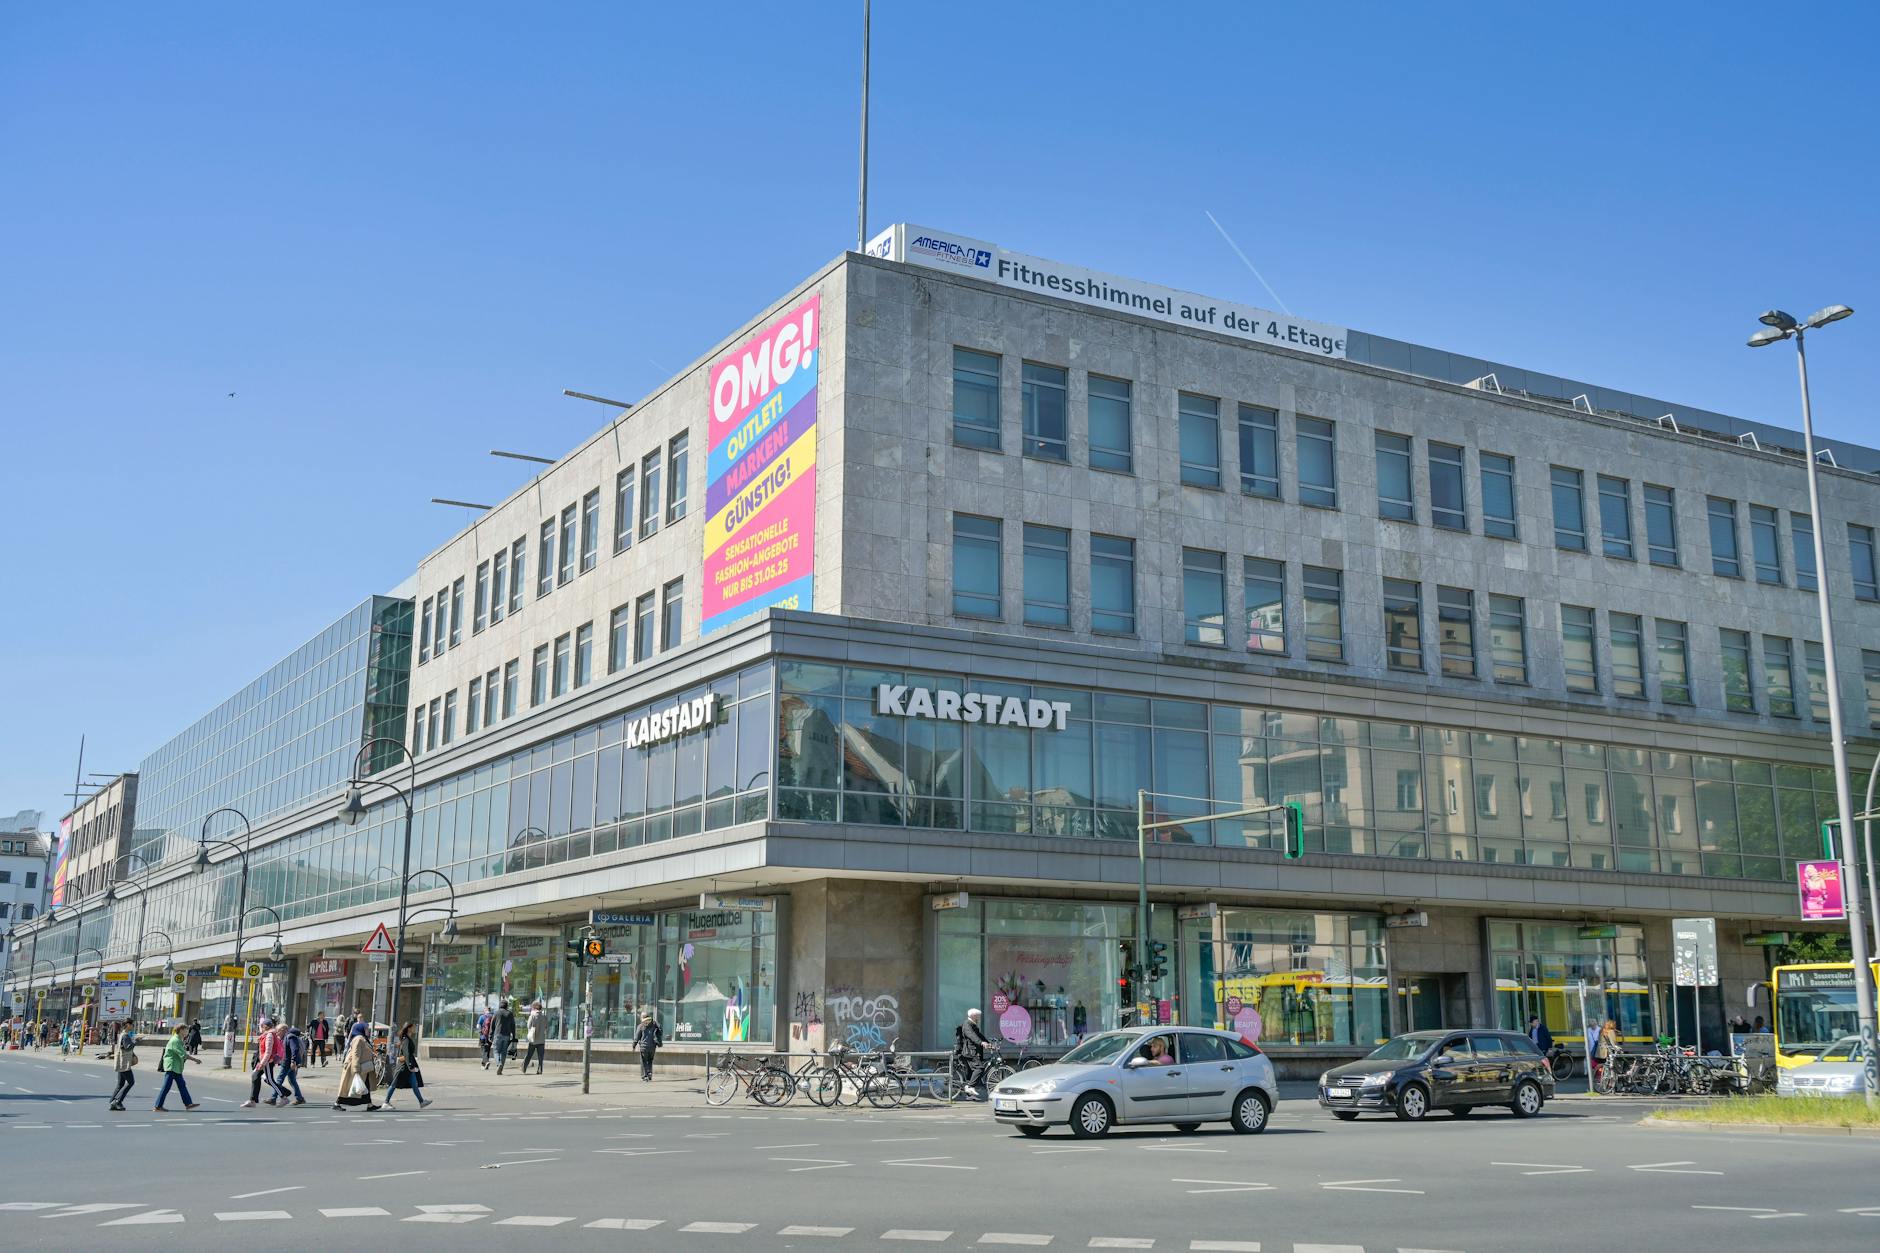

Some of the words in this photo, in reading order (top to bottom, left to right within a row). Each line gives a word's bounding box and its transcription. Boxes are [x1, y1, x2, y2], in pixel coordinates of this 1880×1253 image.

[936, 251, 975, 266] FITNESS
[998, 259, 1172, 315] Fitnesshimmel
[1180, 303, 1217, 325] auf
[1224, 311, 1260, 334] der
[1266, 321, 1345, 355] 4.Etage
[713, 309, 814, 423] OMG!
[727, 391, 783, 460] OUTLET!
[727, 420, 789, 496] MARKEN!
[725, 457, 791, 533] GÜNSTIG!
[715, 533, 799, 585] FASHION-ANGEBOTE
[725, 518, 789, 561] SENSATIONELLE
[723, 582, 739, 600] NUR
[740, 578, 753, 593] BIS
[754, 558, 789, 587] 31.05.25
[626, 693, 717, 750] KARSTADT
[878, 684, 1071, 731] KARSTADT
[611, 914, 651, 922] GALERIA
[688, 911, 743, 931] Hugendubel
[825, 995, 899, 1030] TACOS
[1000, 1019, 1027, 1027] BEAUTY
